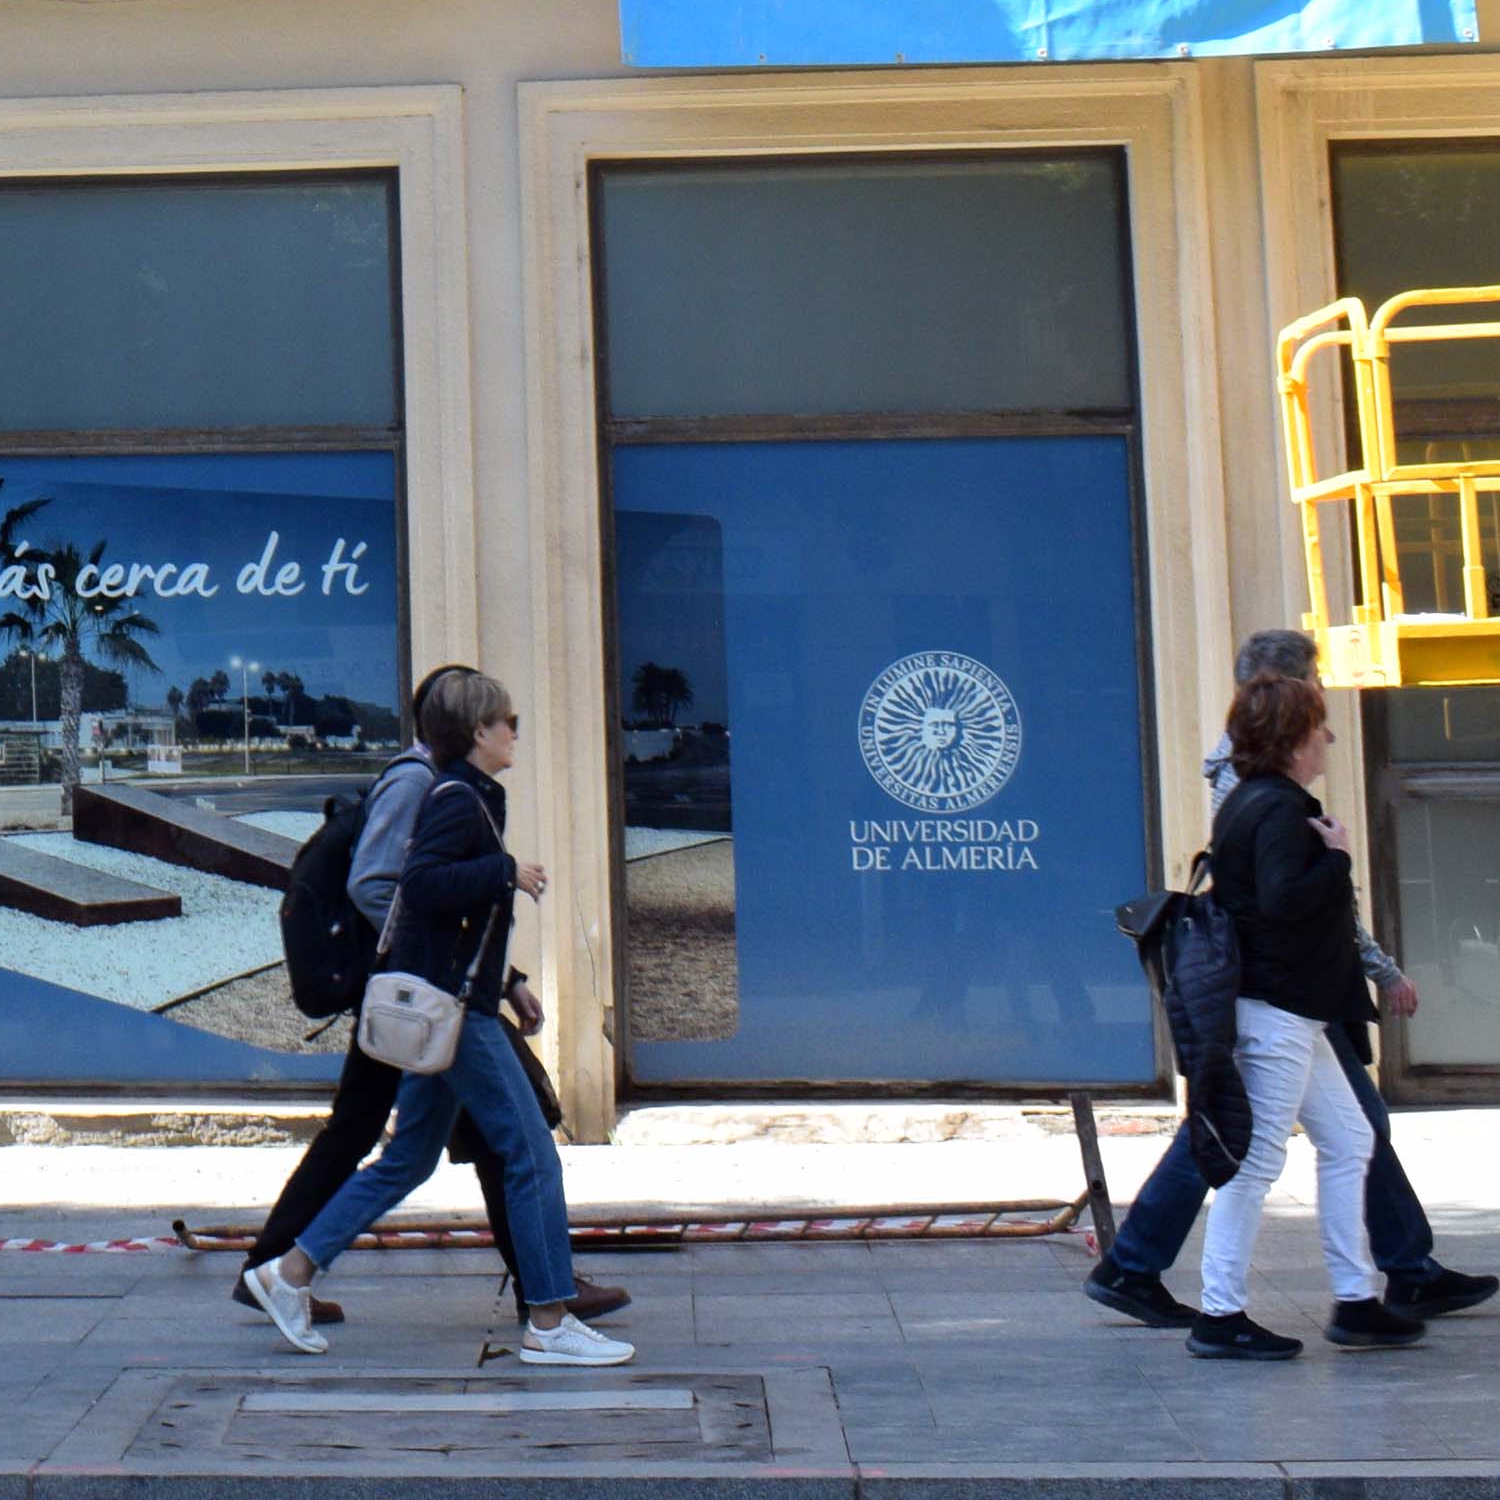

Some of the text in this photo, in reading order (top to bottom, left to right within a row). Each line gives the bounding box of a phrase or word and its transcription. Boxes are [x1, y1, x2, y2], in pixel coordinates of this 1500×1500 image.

[75, 561, 220, 598] cerca
[236, 530, 306, 597] de
[864, 654, 1012, 715] IN LUMINE SAPIENTIA
[861, 723, 1020, 811] UNIVERSITAS ALMERIENSIS
[849, 819, 1040, 843] UNIVERSIDAD
[851, 841, 1039, 871] DE ALMERÍA
